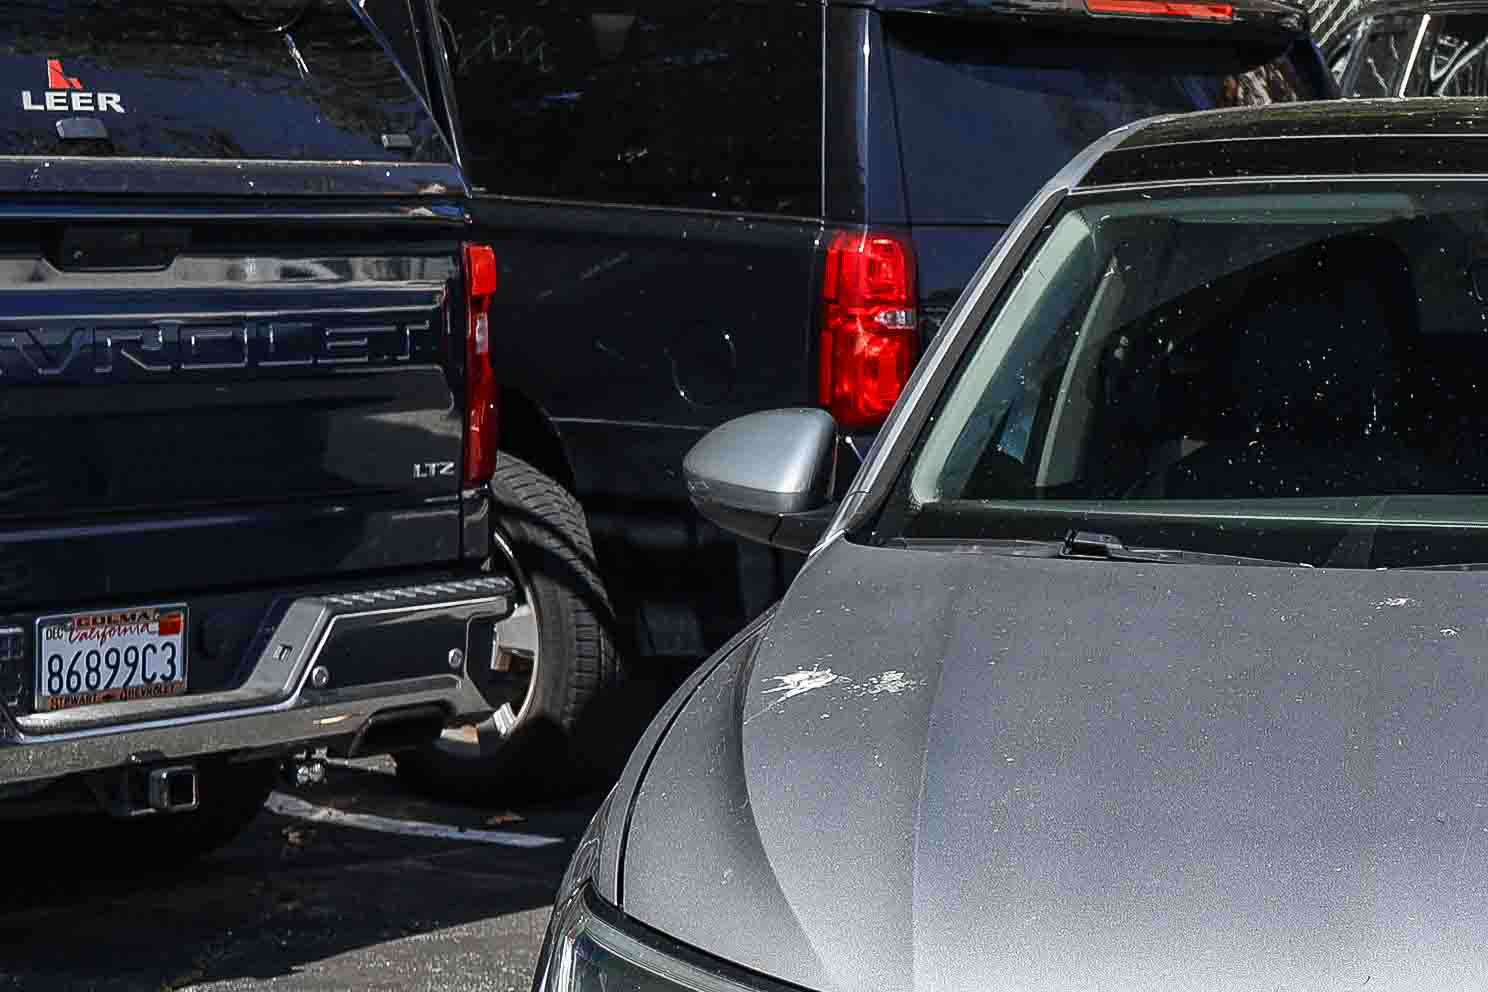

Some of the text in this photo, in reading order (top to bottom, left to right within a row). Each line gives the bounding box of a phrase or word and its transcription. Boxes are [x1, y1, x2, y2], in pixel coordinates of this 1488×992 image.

[22, 90, 126, 113] LEER
[0, 320, 430, 375] VROLET
[412, 461, 455, 479] LTZ
[47, 641, 177, 695] 86899C3
